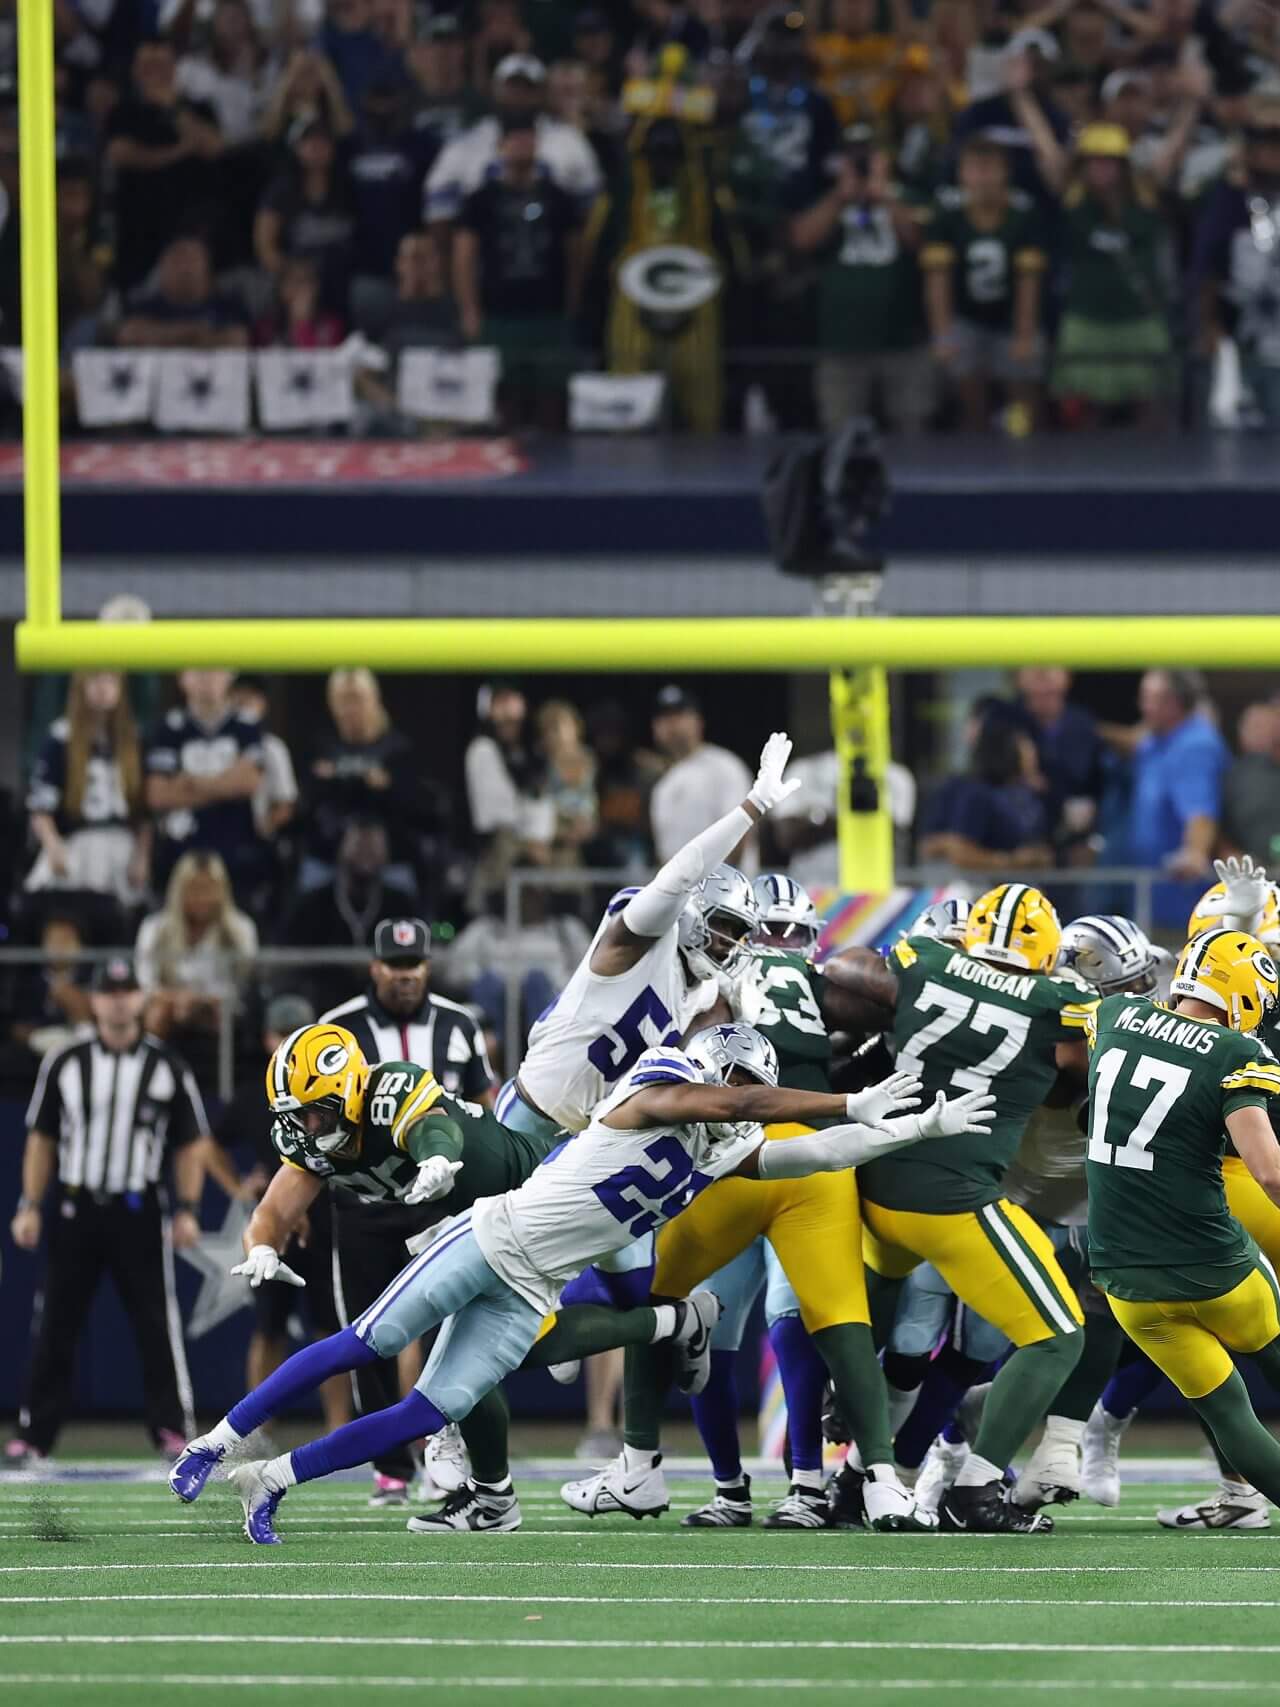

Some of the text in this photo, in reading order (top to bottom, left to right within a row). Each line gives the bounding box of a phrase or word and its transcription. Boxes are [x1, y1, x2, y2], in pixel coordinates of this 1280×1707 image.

[967, 239, 1005, 300] 2
[944, 953, 1037, 1001] MORGAN
[894, 980, 1032, 1092] 77
[1113, 1006, 1221, 1055] McMANUS
[370, 1072, 409, 1126] 85
[1087, 1047, 1192, 1171] 17
